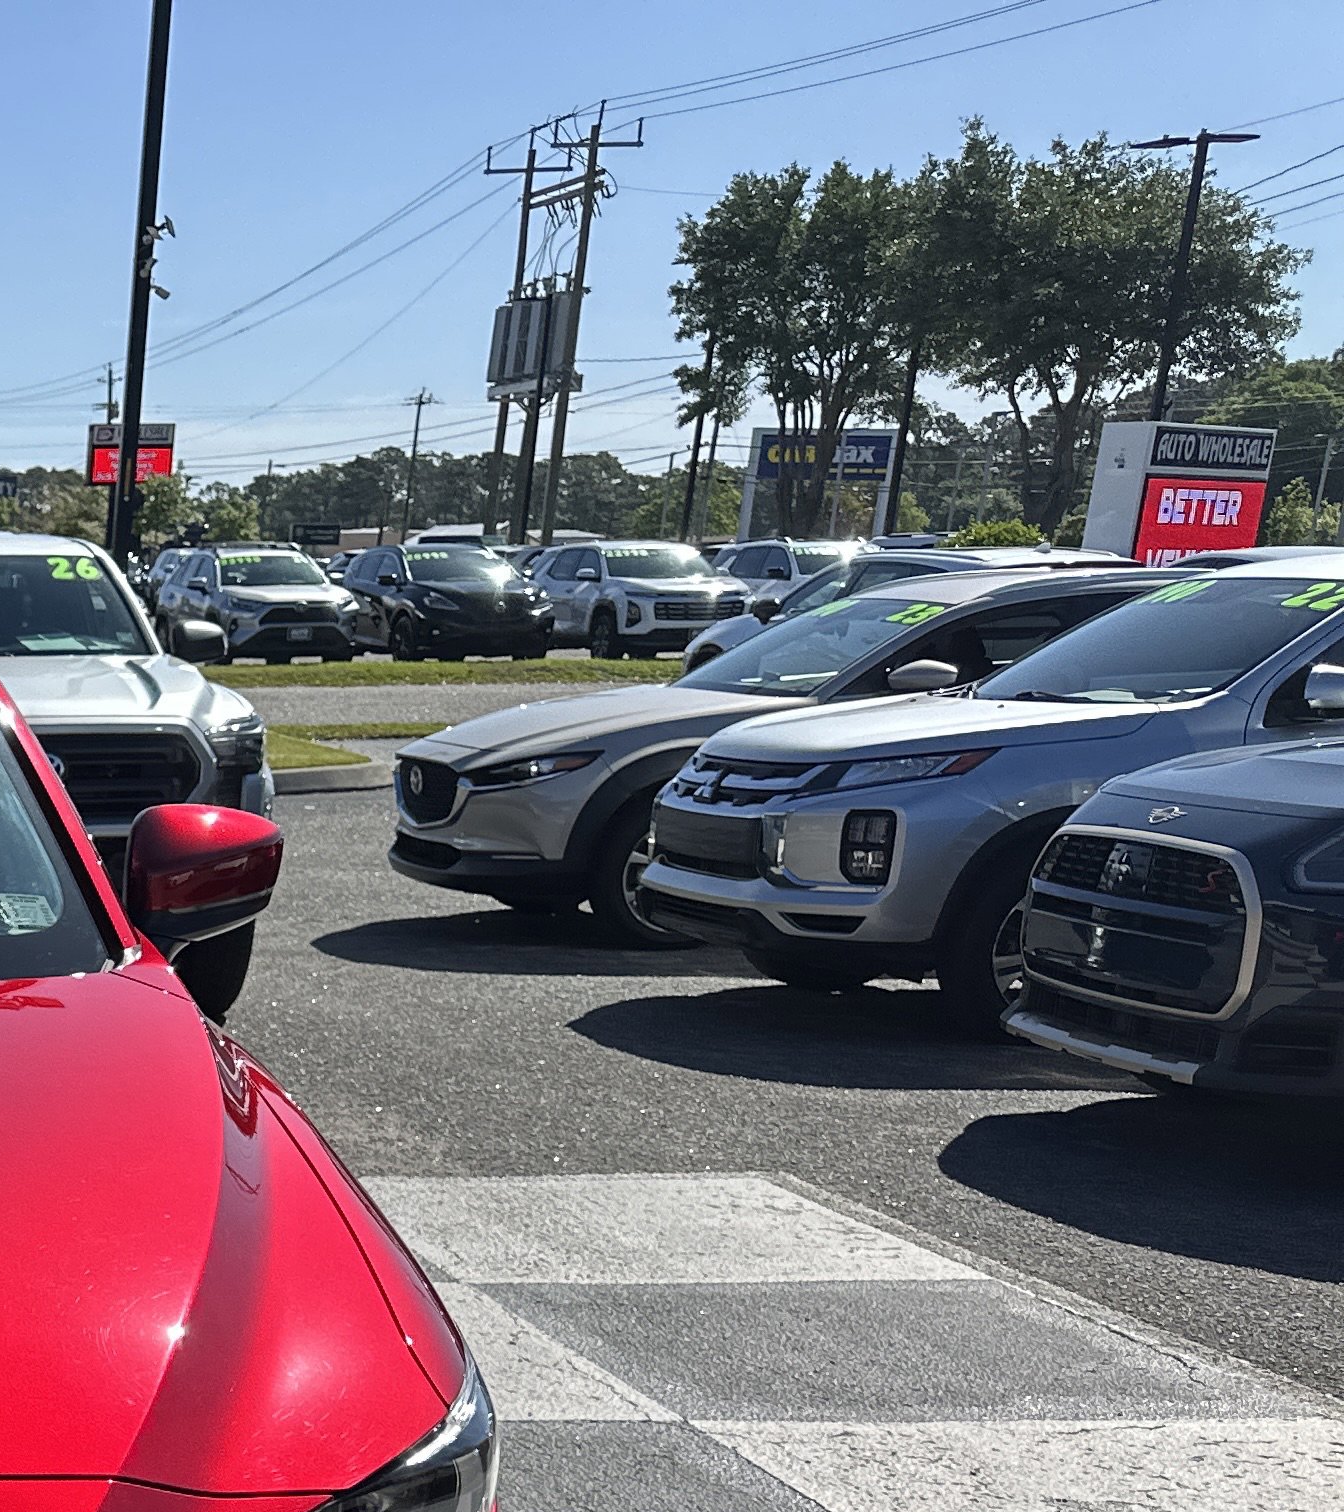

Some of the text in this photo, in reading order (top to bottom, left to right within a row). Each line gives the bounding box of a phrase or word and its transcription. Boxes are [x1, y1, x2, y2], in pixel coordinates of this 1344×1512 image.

[1157, 433, 1272, 466] AUTO WHOLESALE
[1156, 488, 1243, 526] BETTER
[46, 557, 102, 581] 26
[1281, 582, 1344, 611] 22
[885, 603, 945, 625] 23
